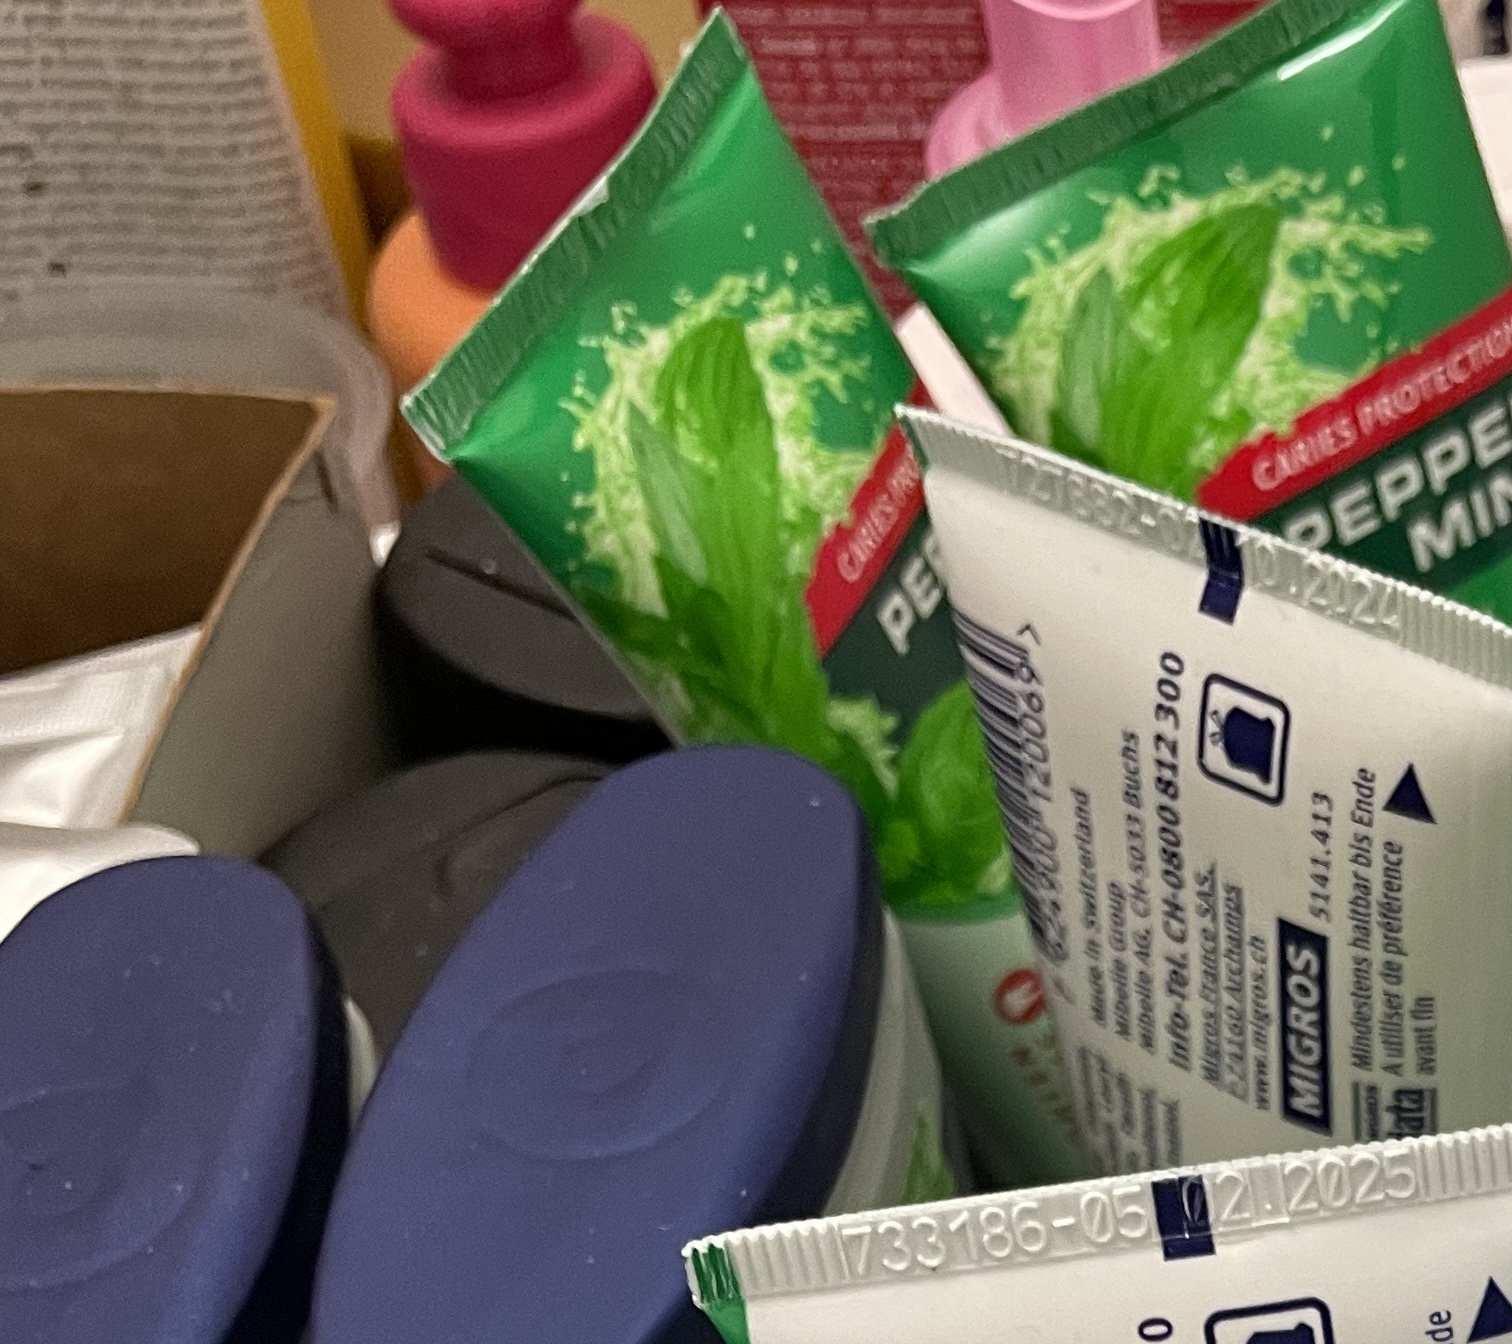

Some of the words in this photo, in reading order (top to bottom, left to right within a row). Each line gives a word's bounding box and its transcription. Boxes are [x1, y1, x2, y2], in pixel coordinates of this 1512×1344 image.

[1154, 651, 1185, 730] 300
[1153, 733, 1179, 802] 812
[1350, 768, 1376, 829] Ende
[1156, 804, 1187, 944] CH-0800
[1309, 791, 1333, 923] 5141.413
[1348, 832, 1373, 868] bis
[1347, 871, 1372, 952] haltbar
[1376, 840, 1409, 957] préférence
[1164, 954, 1191, 1072] Info-Tel.
[1380, 960, 1403, 986] de
[1286, 944, 1321, 1117] MIGROS
[1349, 955, 1373, 1072] Mindestens
[1380, 989, 1404, 1058] utiliser
[1381, 1063, 1403, 1078] A
